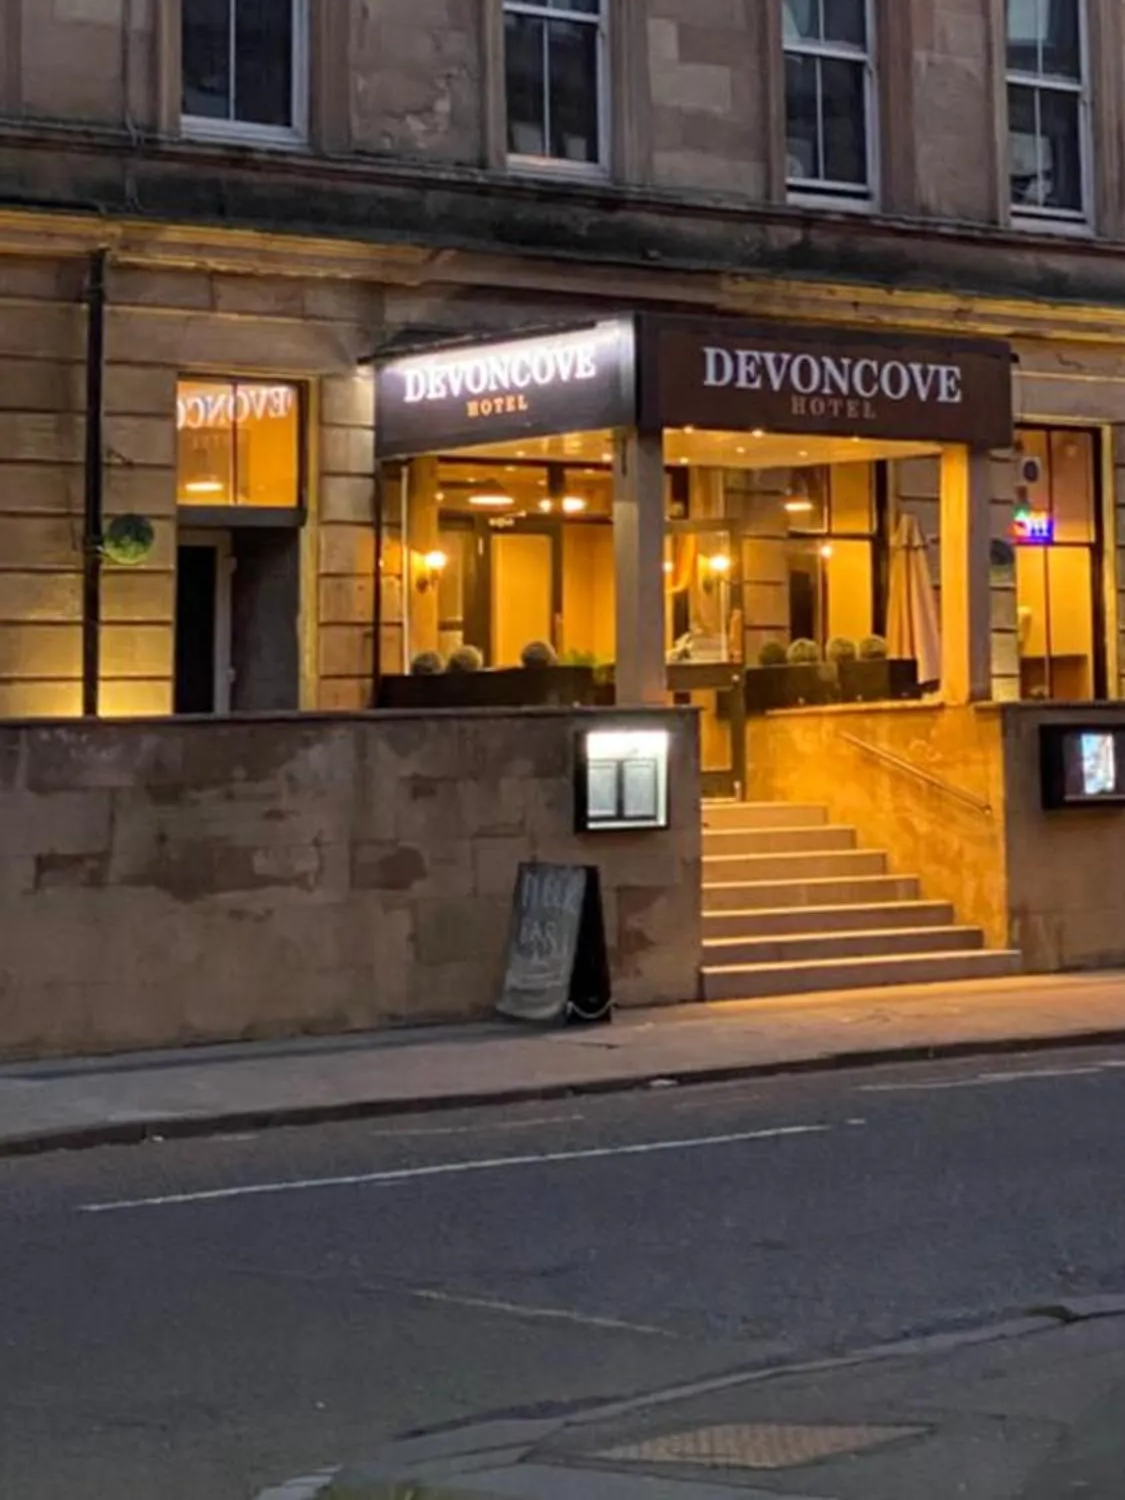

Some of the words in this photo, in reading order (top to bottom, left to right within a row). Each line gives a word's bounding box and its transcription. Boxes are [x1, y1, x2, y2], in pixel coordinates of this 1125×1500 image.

[404, 348, 596, 403] DEVONCOVE
[703, 348, 962, 404] DEVONCOVE
[466, 394, 528, 417] HOTEL
[791, 395, 876, 419] HOTEL
